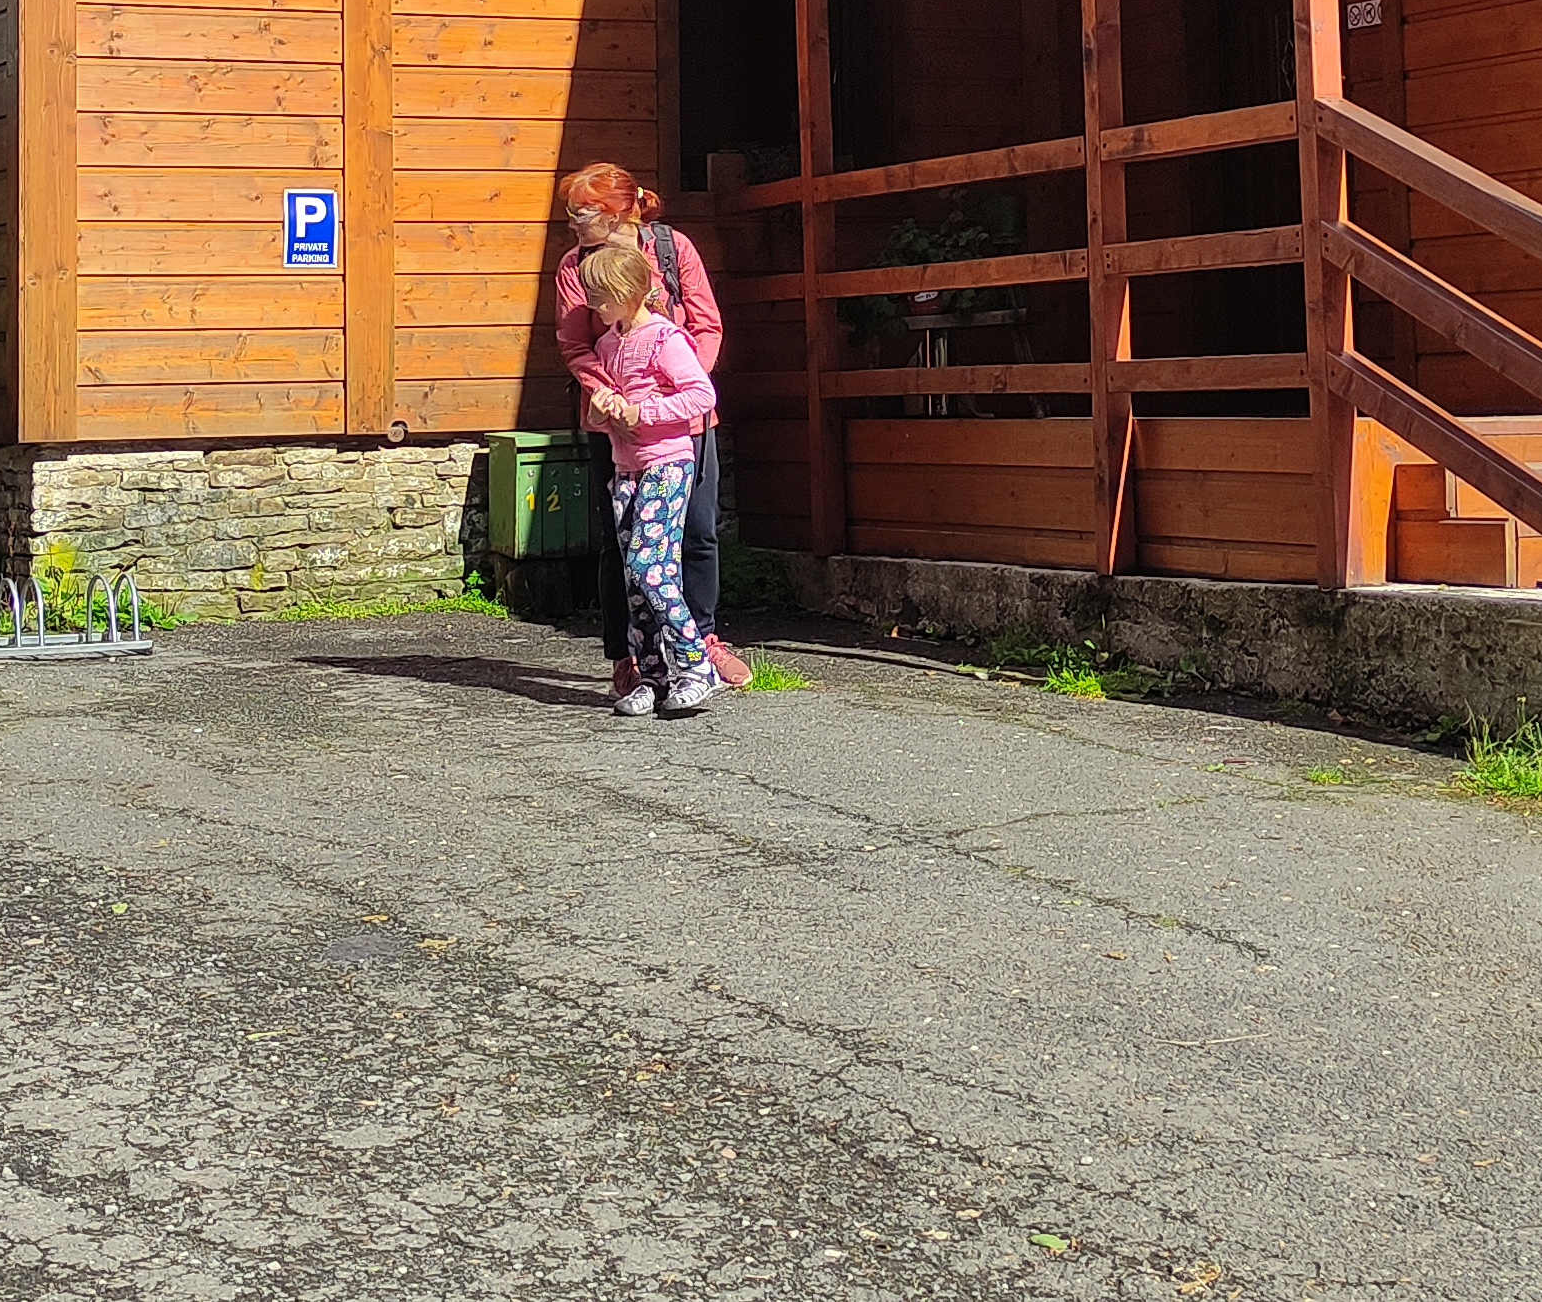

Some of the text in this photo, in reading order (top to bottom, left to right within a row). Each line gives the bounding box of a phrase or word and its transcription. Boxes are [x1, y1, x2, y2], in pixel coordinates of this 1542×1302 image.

[295, 196, 327, 239] P
[293, 242, 329, 252] PRIVATE
[291, 253, 330, 263] PARKING
